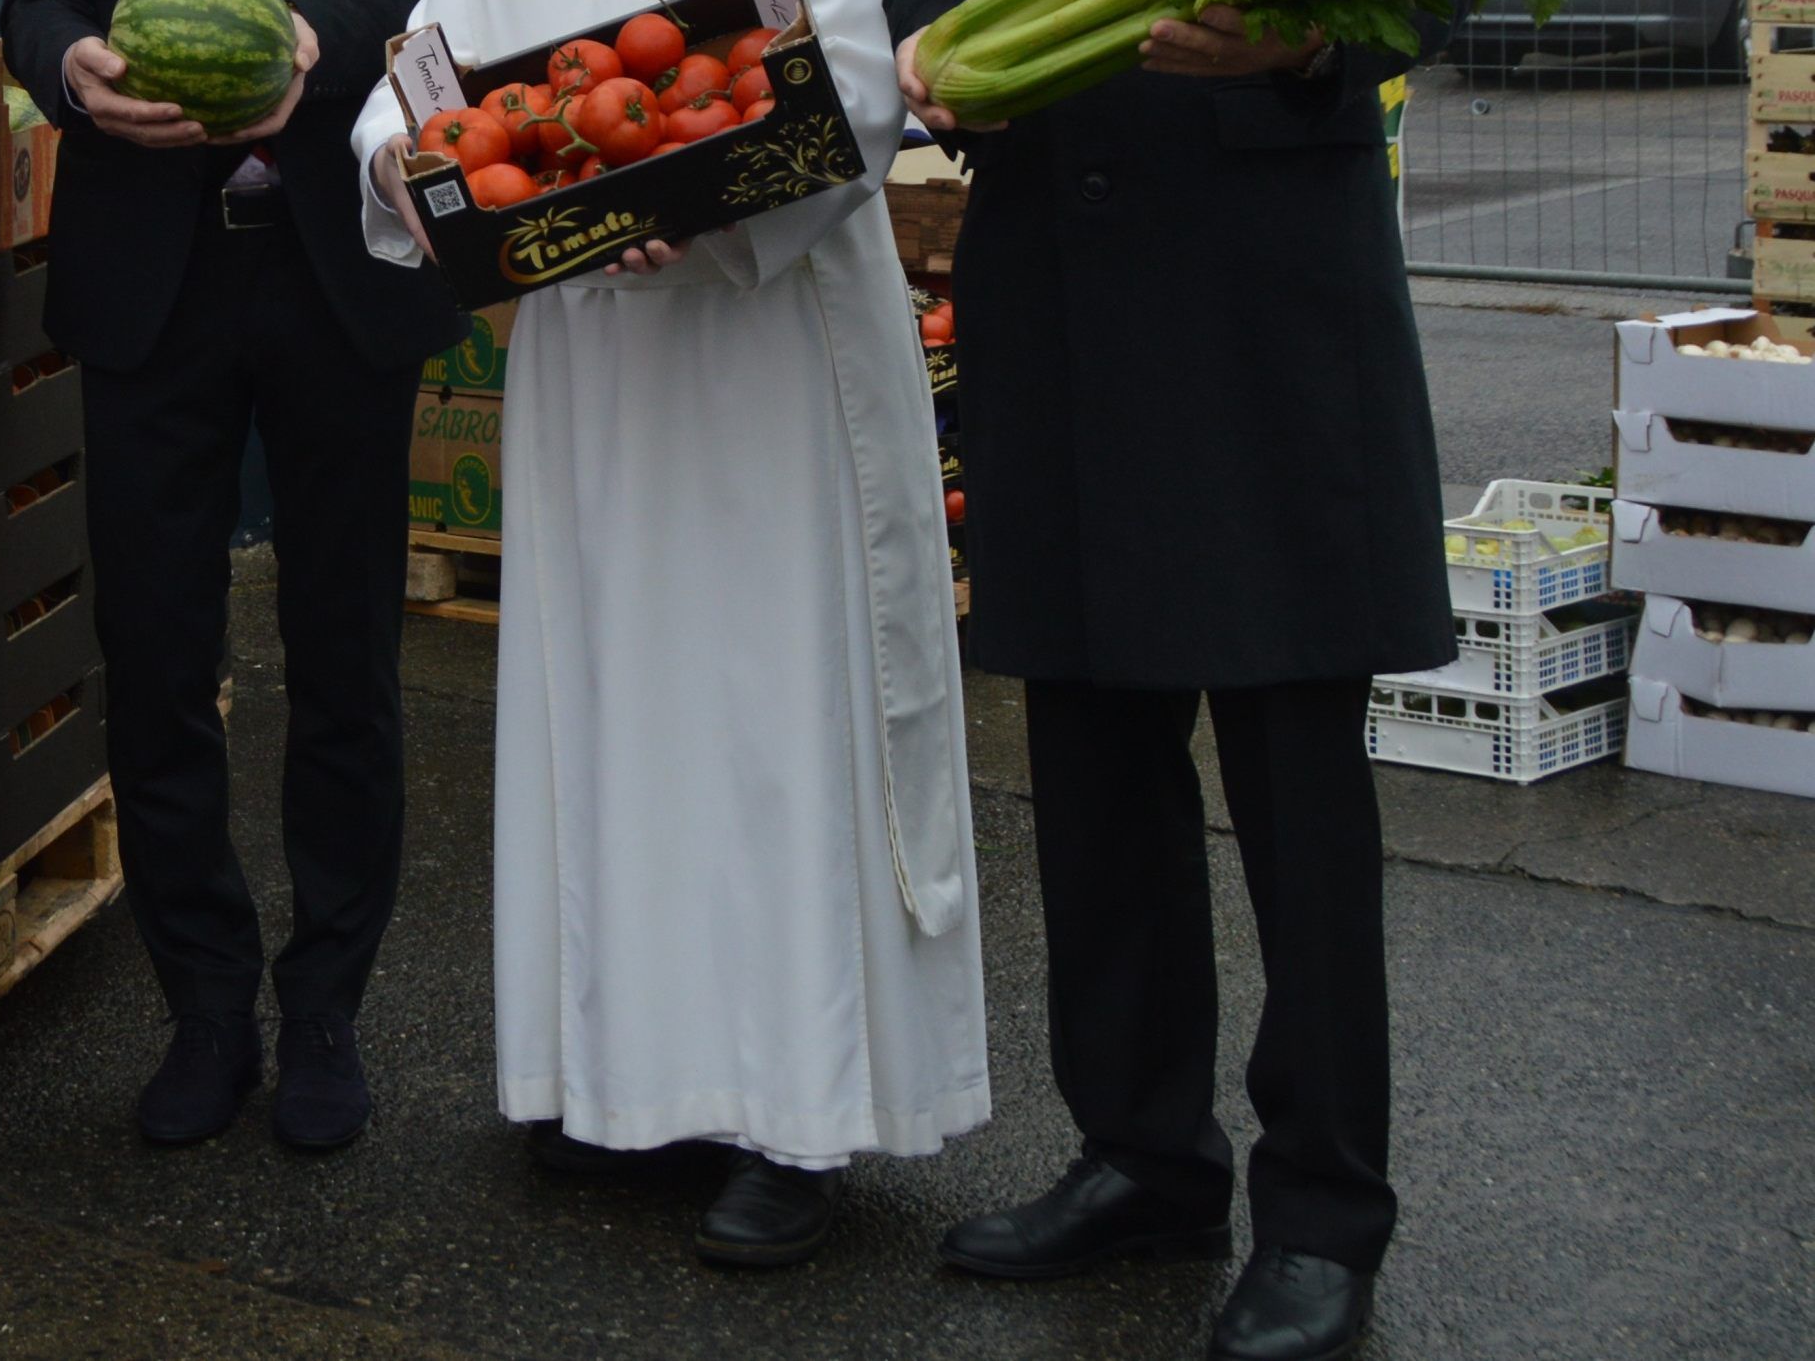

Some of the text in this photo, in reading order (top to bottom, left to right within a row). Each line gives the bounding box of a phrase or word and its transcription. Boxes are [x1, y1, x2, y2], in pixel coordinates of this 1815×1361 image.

[415, 43, 445, 102] Tomato
[512, 211, 634, 271] Tomato
[417, 405, 502, 445] SABRO
